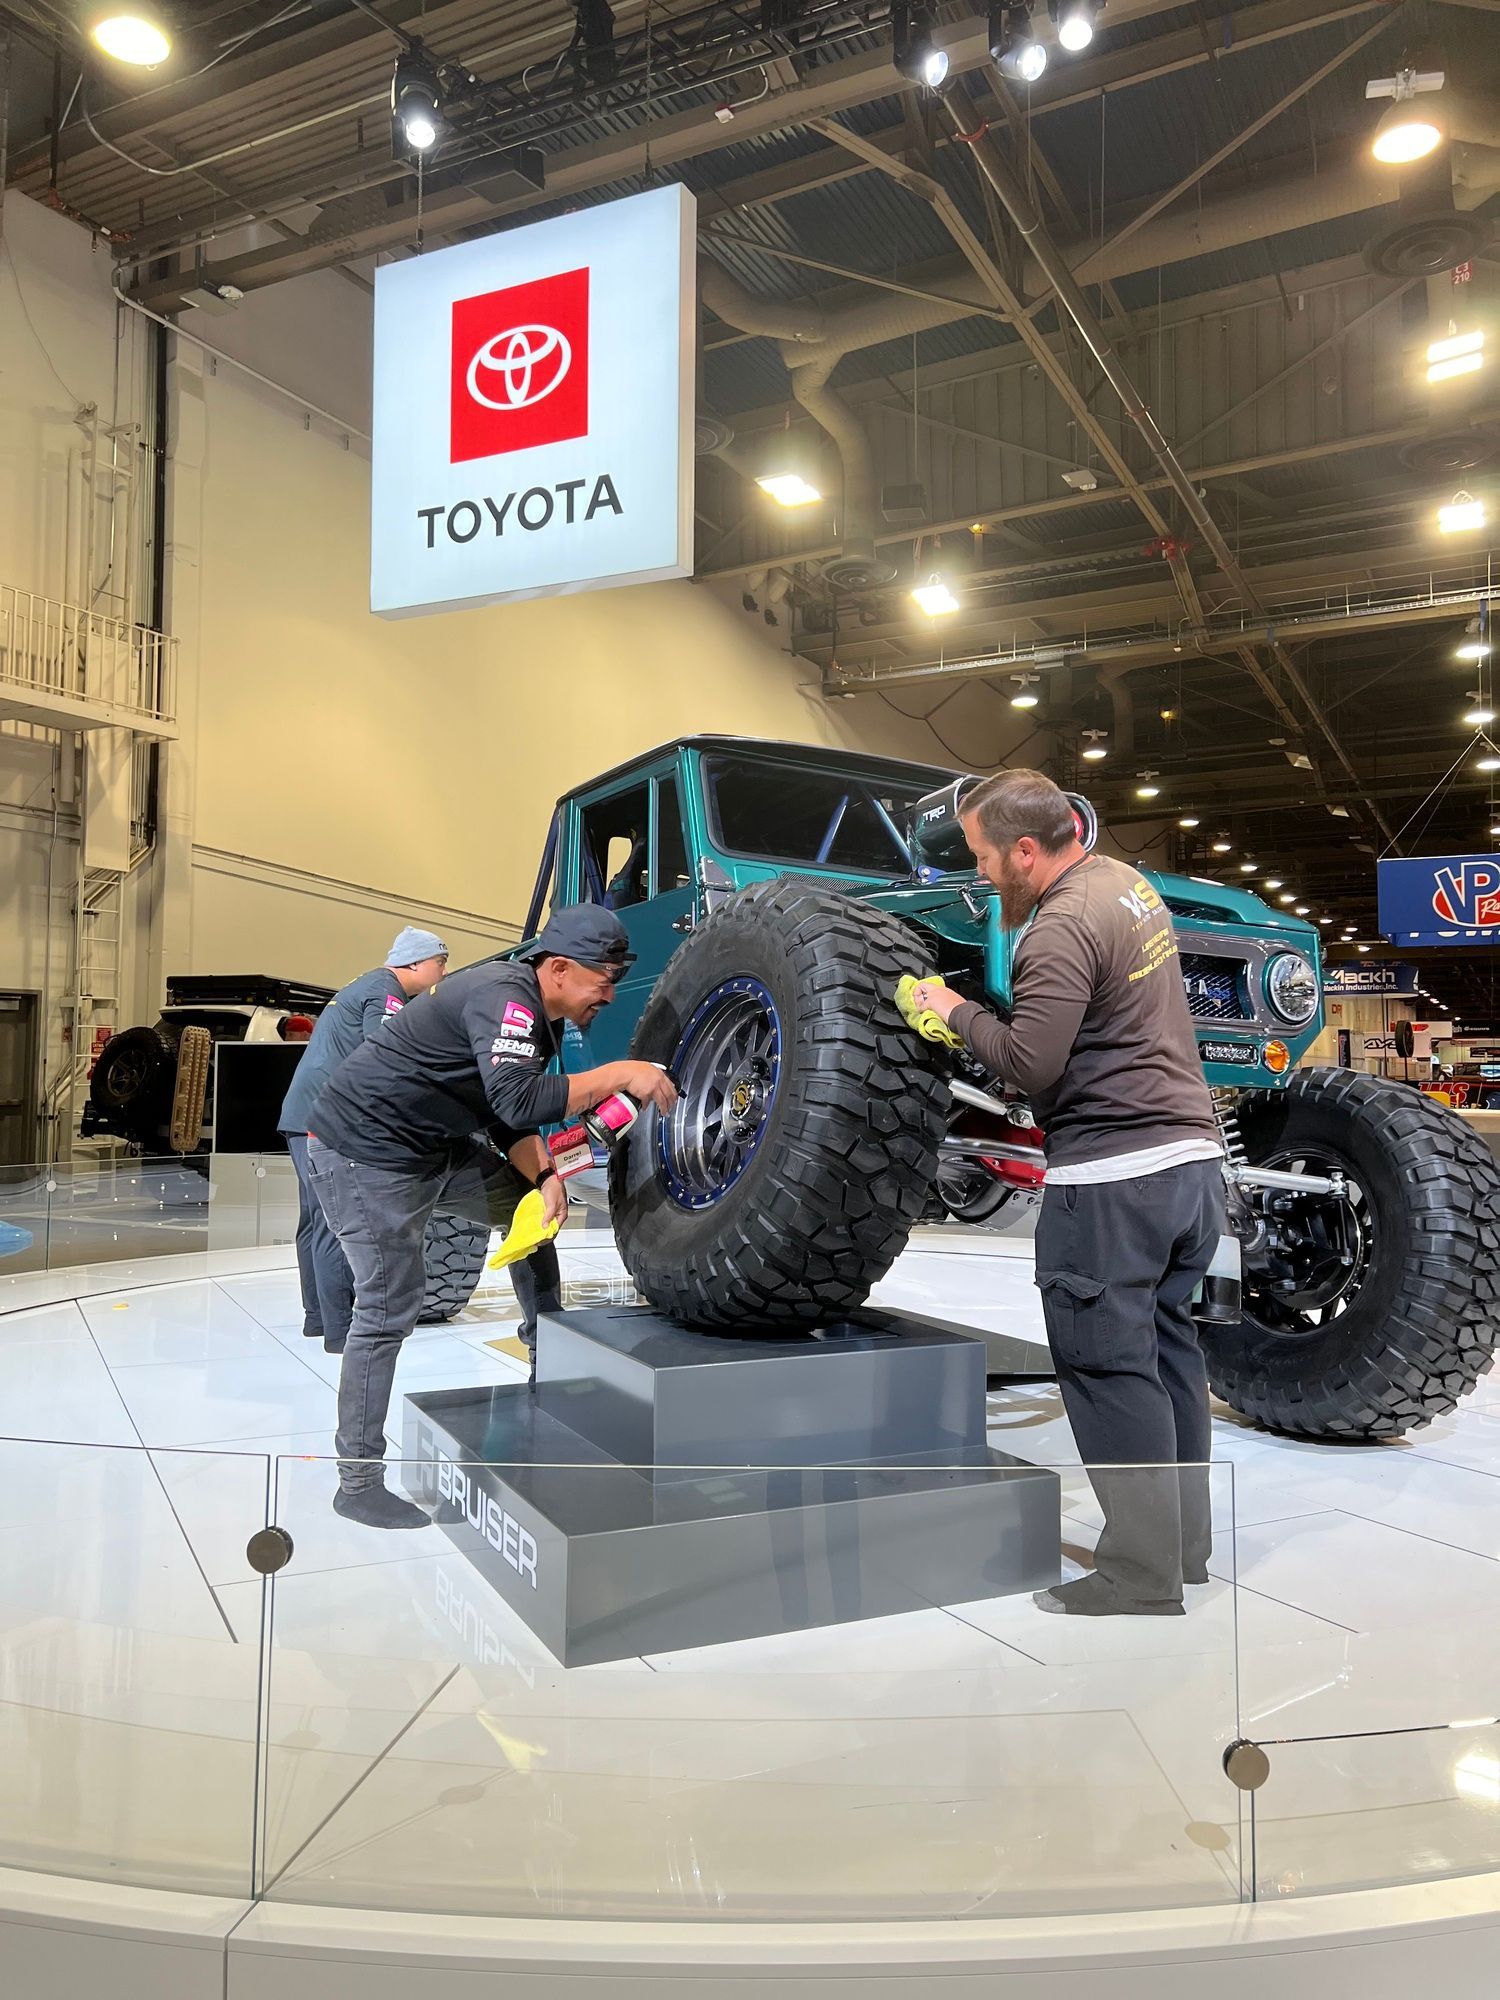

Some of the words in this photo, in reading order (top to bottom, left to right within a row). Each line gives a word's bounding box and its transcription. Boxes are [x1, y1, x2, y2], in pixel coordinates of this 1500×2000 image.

[1454, 271, 1470, 285] 210
[417, 474, 624, 549] TOYOTA
[922, 804, 946, 822] TRD
[1434, 861, 1500, 926] VP
[1329, 968, 1396, 984] Mackin
[437, 1449, 538, 1590] BRUISER
